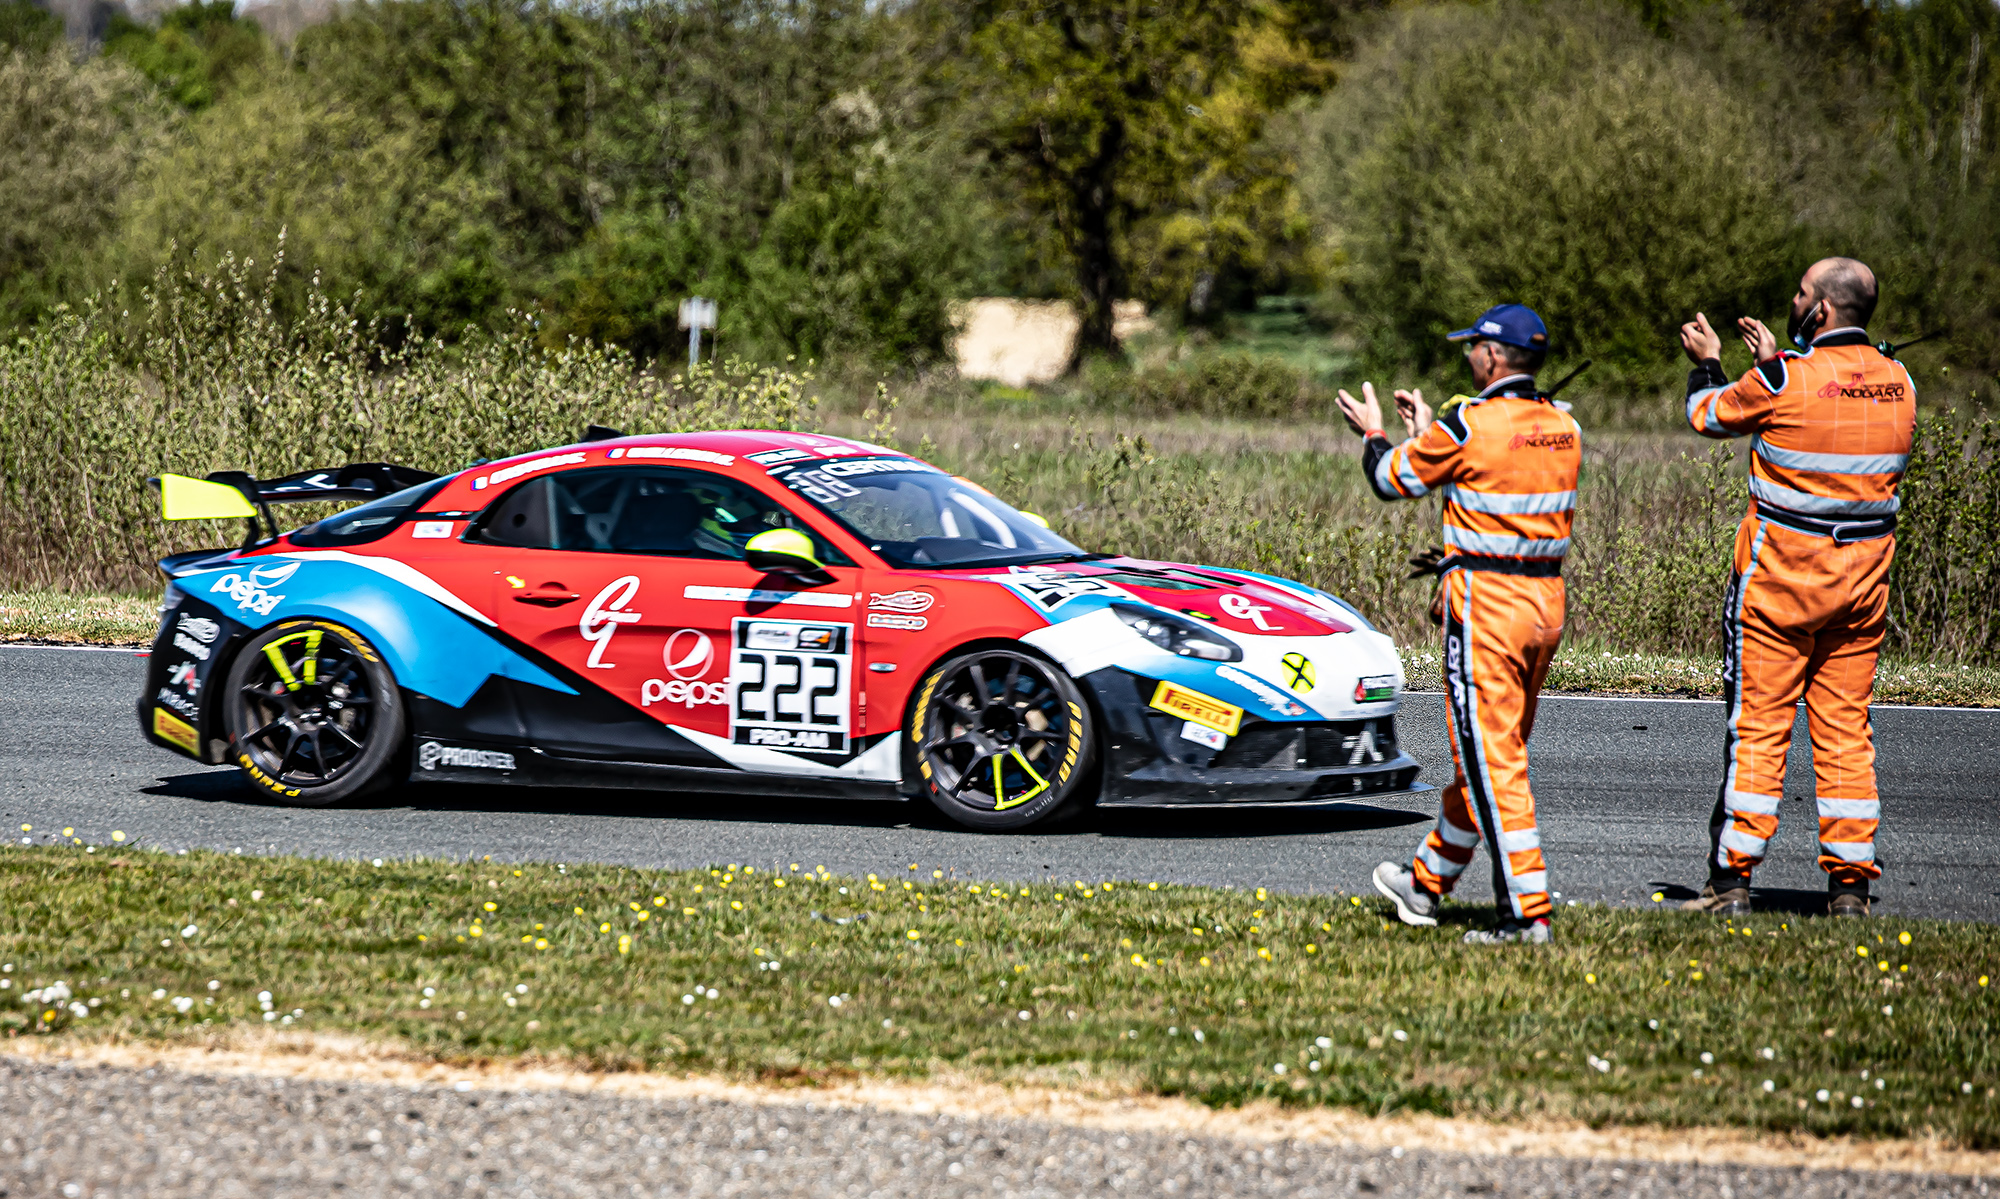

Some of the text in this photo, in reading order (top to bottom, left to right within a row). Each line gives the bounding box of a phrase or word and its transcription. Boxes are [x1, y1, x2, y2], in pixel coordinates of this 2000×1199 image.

[1840, 386, 1905, 399] NOGARO
[209, 573, 287, 616] pepsi
[737, 652, 842, 726] 222
[1162, 687, 1234, 727] PIRELLI
[748, 727, 831, 749] PRO-AM
